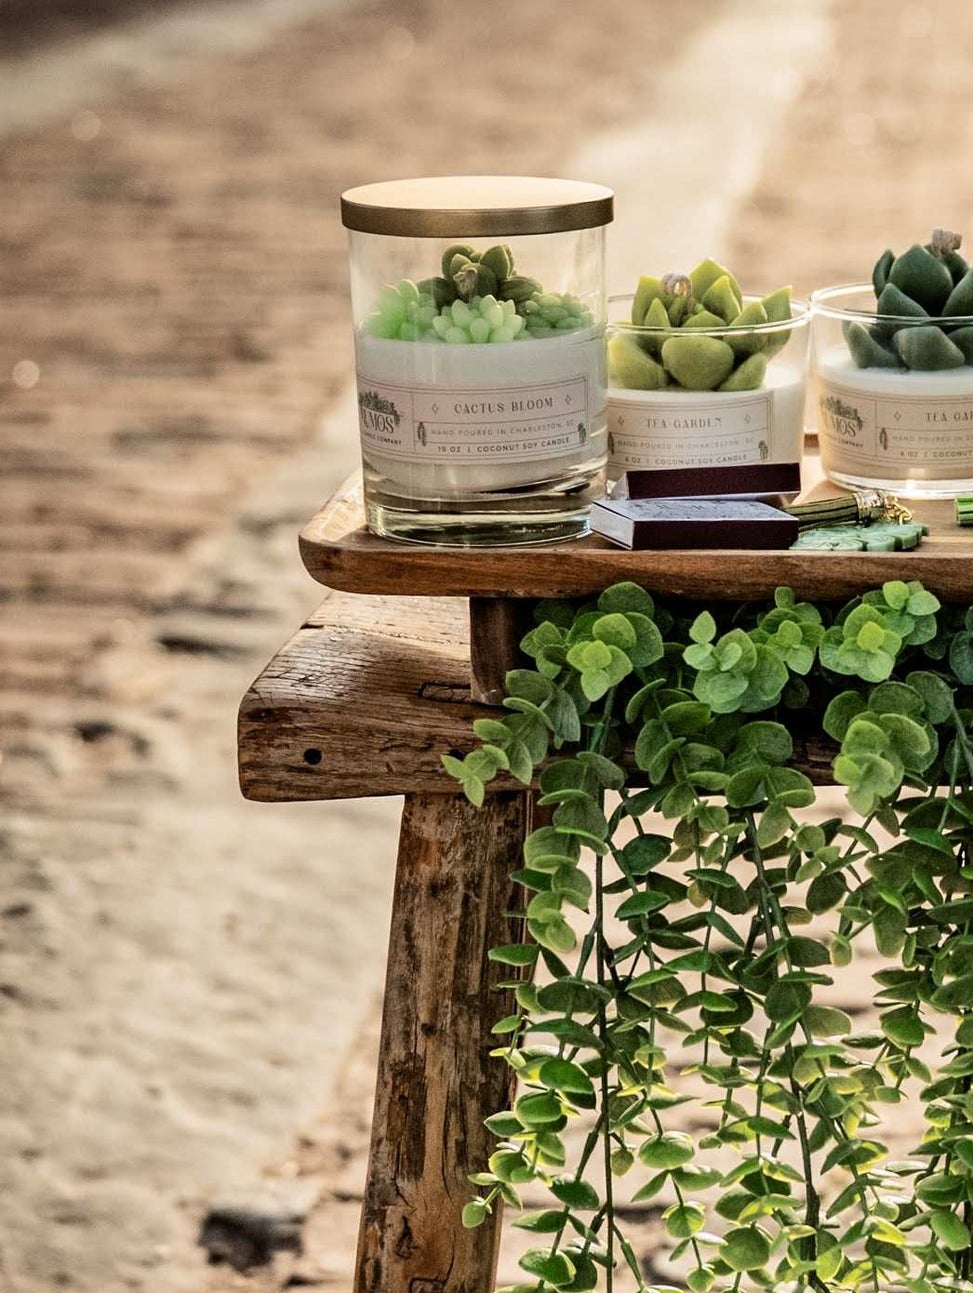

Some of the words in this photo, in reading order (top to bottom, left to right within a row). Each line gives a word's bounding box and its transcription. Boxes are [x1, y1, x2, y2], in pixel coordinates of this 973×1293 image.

[454, 402, 505, 415] CACTUS
[511, 397, 553, 412] BLOOM
[647, 418, 667, 429] TEA
[673, 417, 722, 429] GARDEN
[926, 412, 948, 423] TEA
[477, 444, 519, 453] COCONUT
[523, 442, 538, 450] SOY
[541, 437, 570, 448] CANDLE
[632, 456, 641, 464] OZ
[654, 458, 695, 466] COCONUT
[698, 456, 714, 465] SOY
[716, 453, 747, 463] CANDLE
[933, 450, 973, 458] COCONUT
